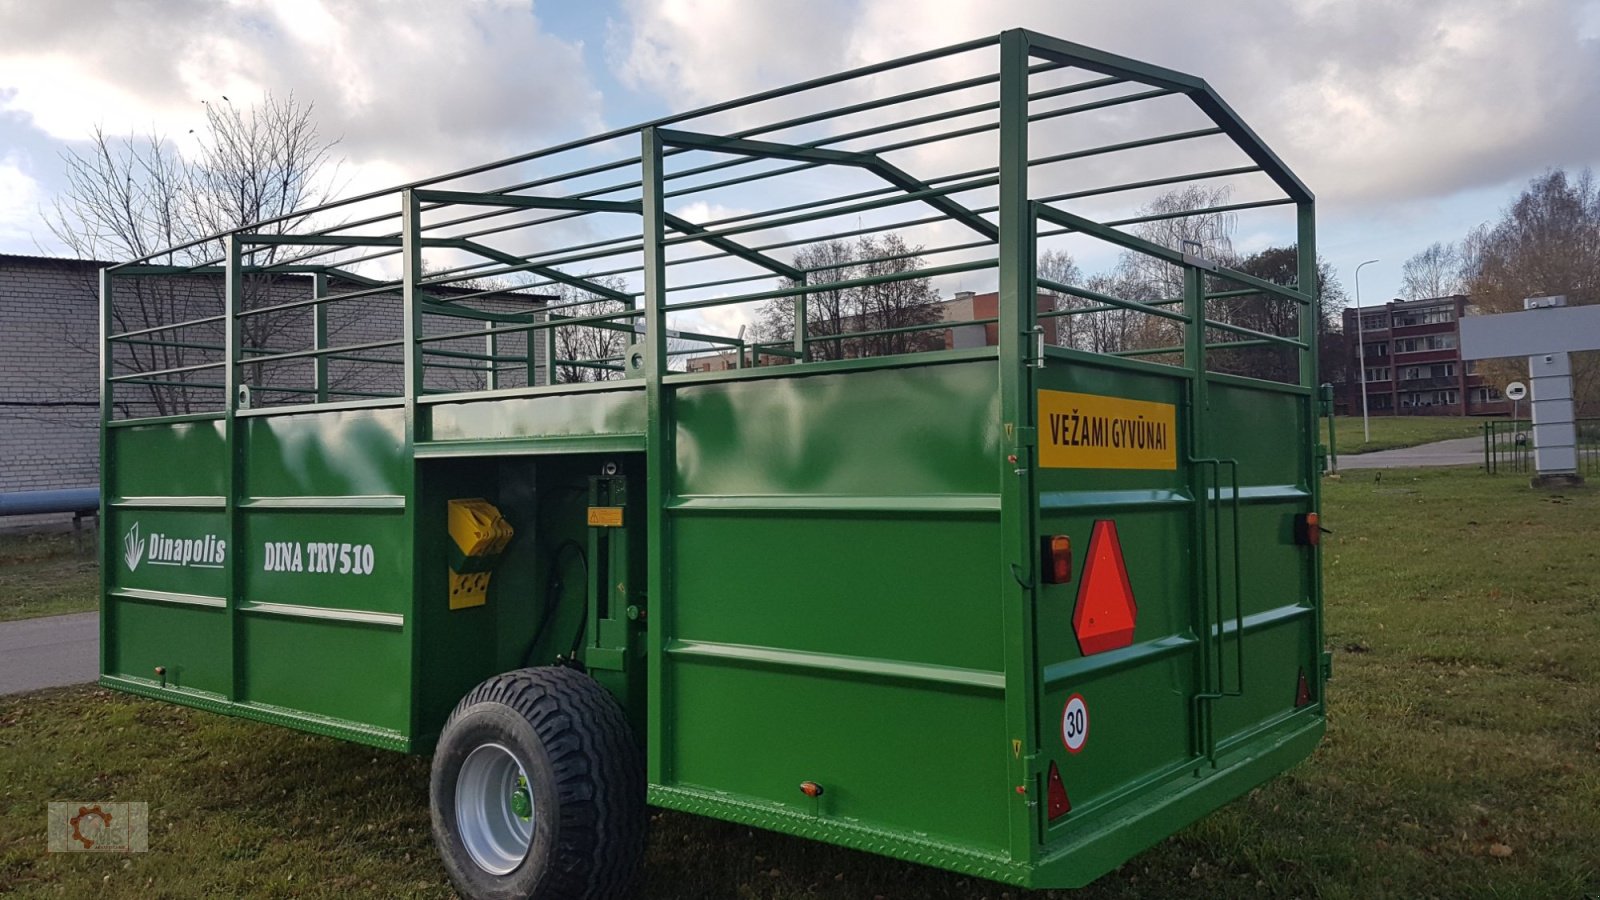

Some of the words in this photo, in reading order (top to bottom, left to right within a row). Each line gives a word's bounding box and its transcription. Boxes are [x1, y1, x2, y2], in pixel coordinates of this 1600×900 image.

[1050, 408, 1109, 448] VEŽAMI
[1111, 415, 1167, 450] GYVŪNAI
[148, 533, 226, 566] Dinapolis
[264, 542, 304, 572] DINA
[1067, 708, 1084, 738] 30
